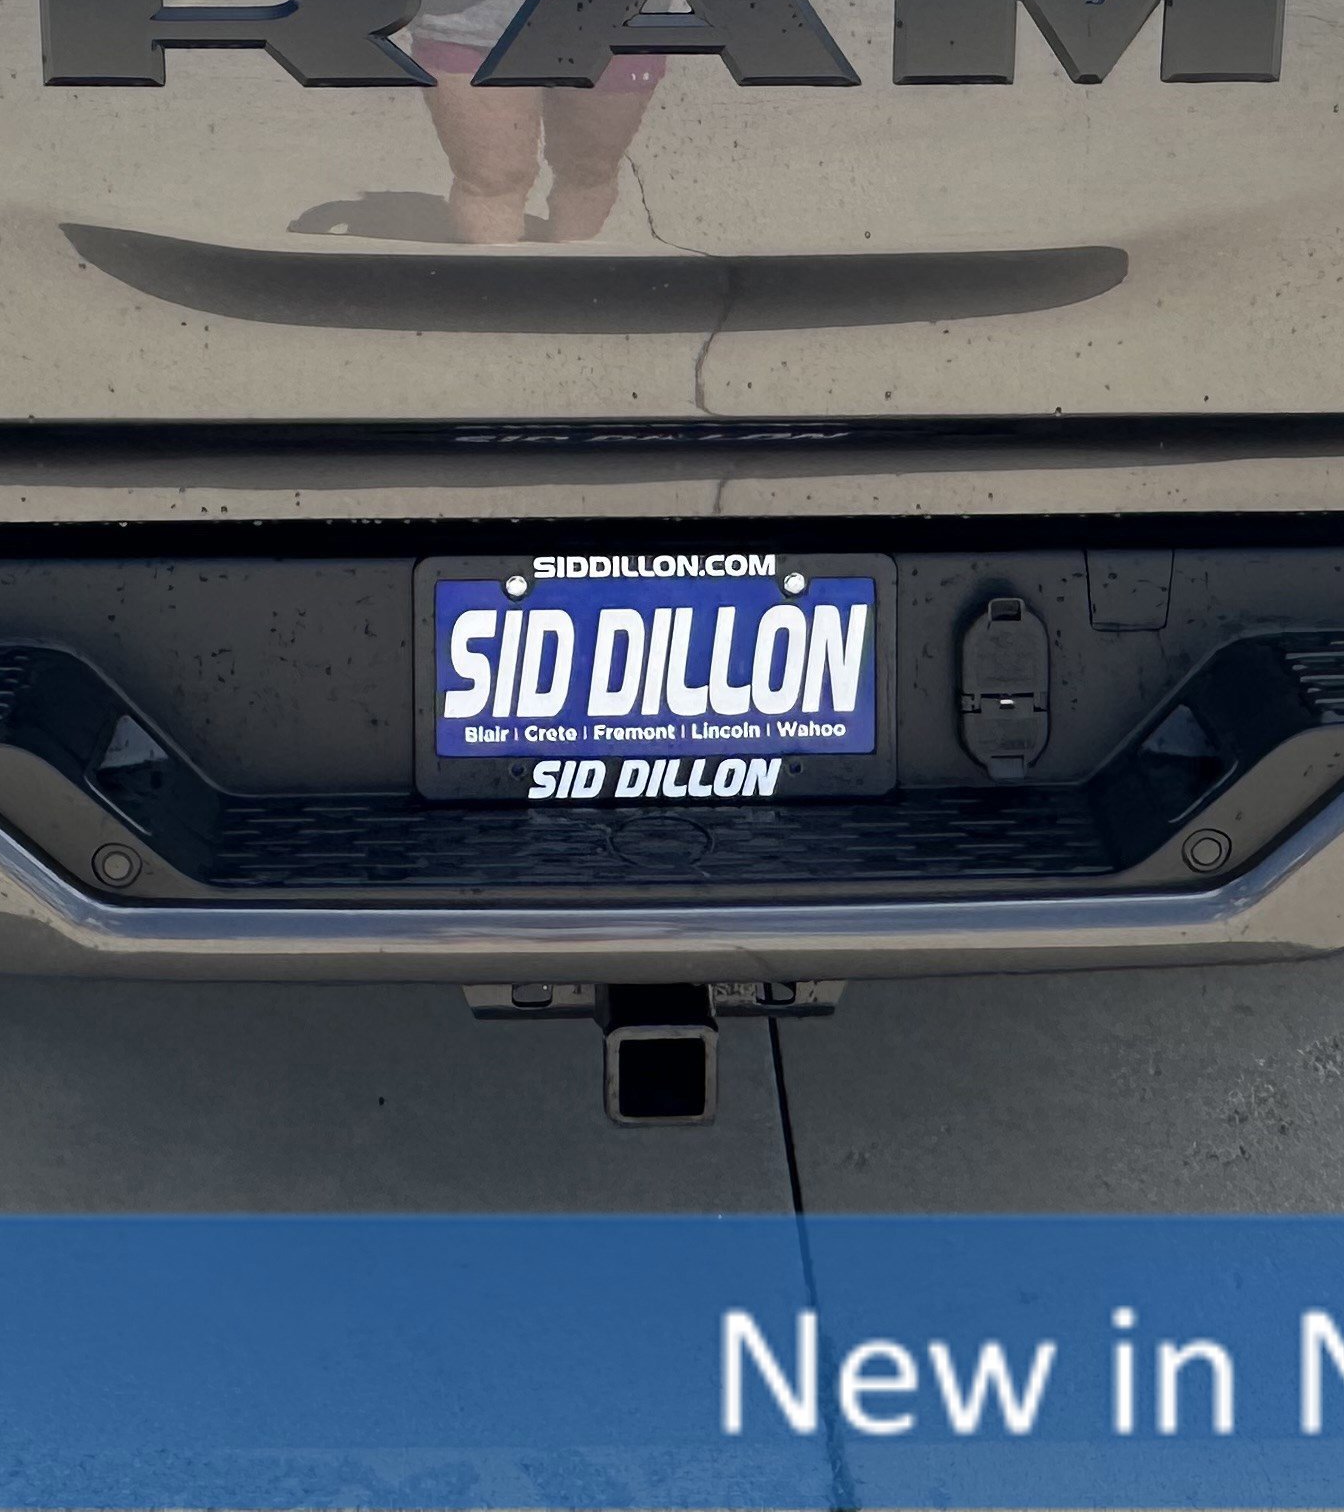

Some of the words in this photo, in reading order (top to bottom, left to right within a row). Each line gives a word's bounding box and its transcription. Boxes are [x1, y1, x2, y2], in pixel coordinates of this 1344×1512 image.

[532, 554, 776, 579] SIDDILLON.COM
[443, 608, 576, 719] SID
[587, 603, 868, 717] DILLON
[464, 726, 509, 743] Blair
[524, 725, 578, 742] Crete
[593, 724, 676, 740] Fremont
[691, 722, 761, 739] Lincoln
[776, 721, 847, 737] Wahoo
[528, 760, 605, 799] SID
[614, 757, 782, 799] DILLON
